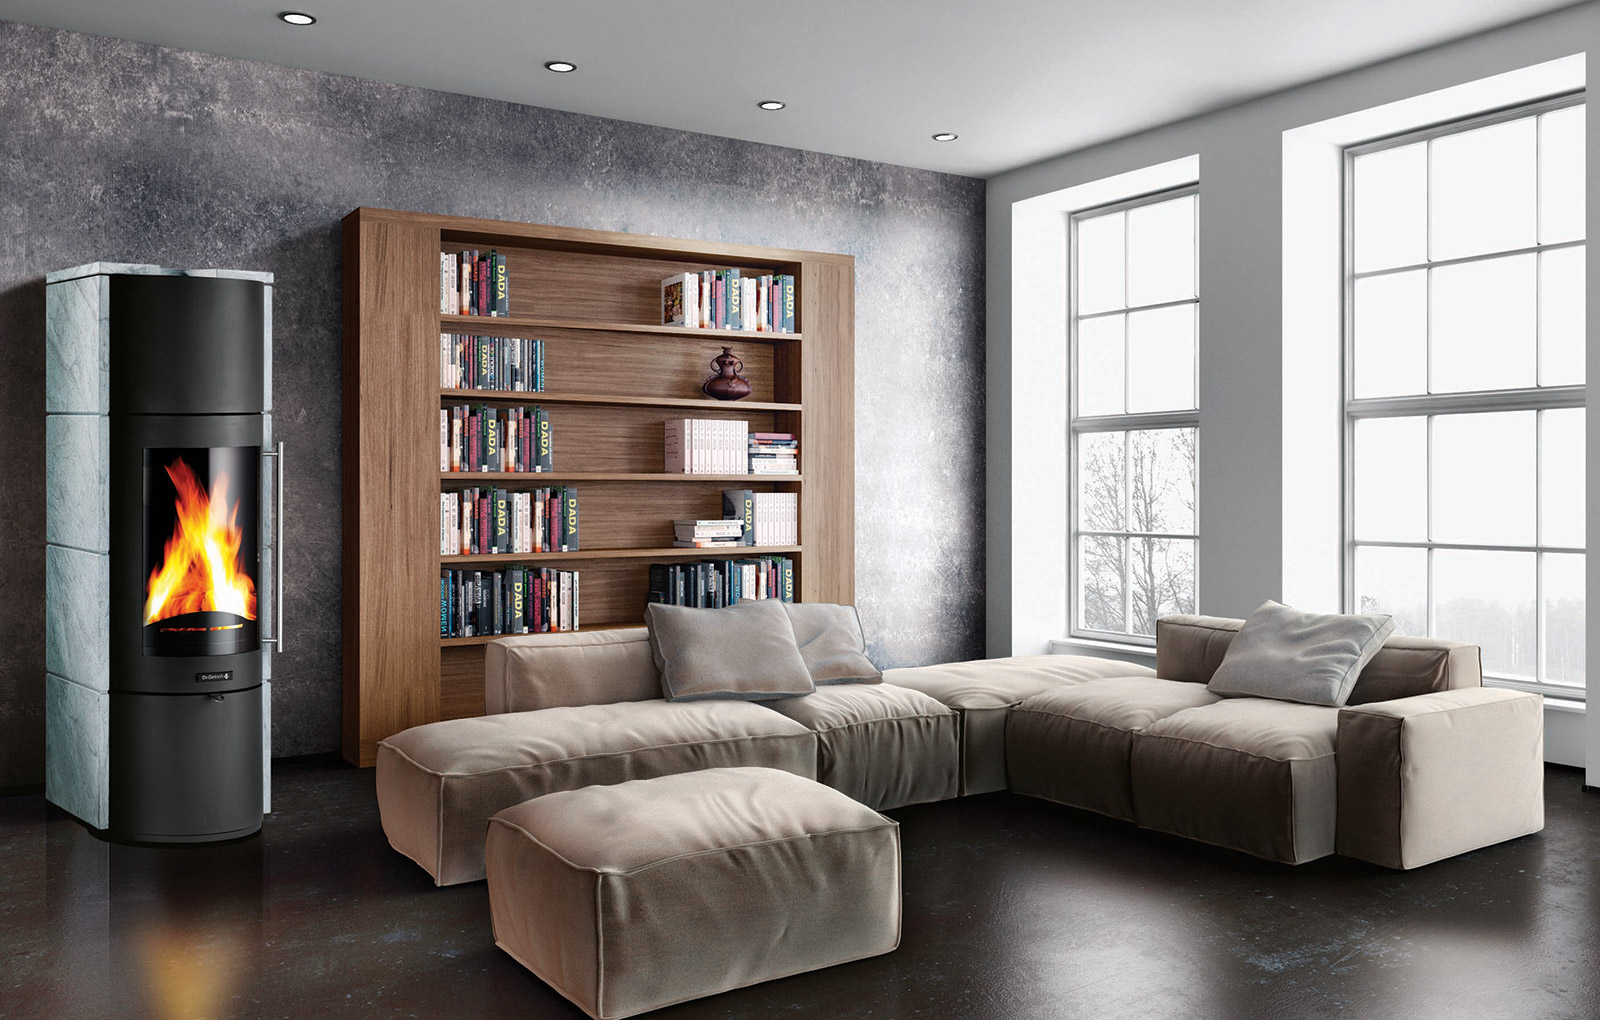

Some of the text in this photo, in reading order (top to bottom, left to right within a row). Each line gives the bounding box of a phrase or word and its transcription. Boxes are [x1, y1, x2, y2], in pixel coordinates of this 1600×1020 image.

[498, 265, 506, 300] DADA
[498, 500, 506, 535] DADA
[514, 582, 522, 618] DADA
